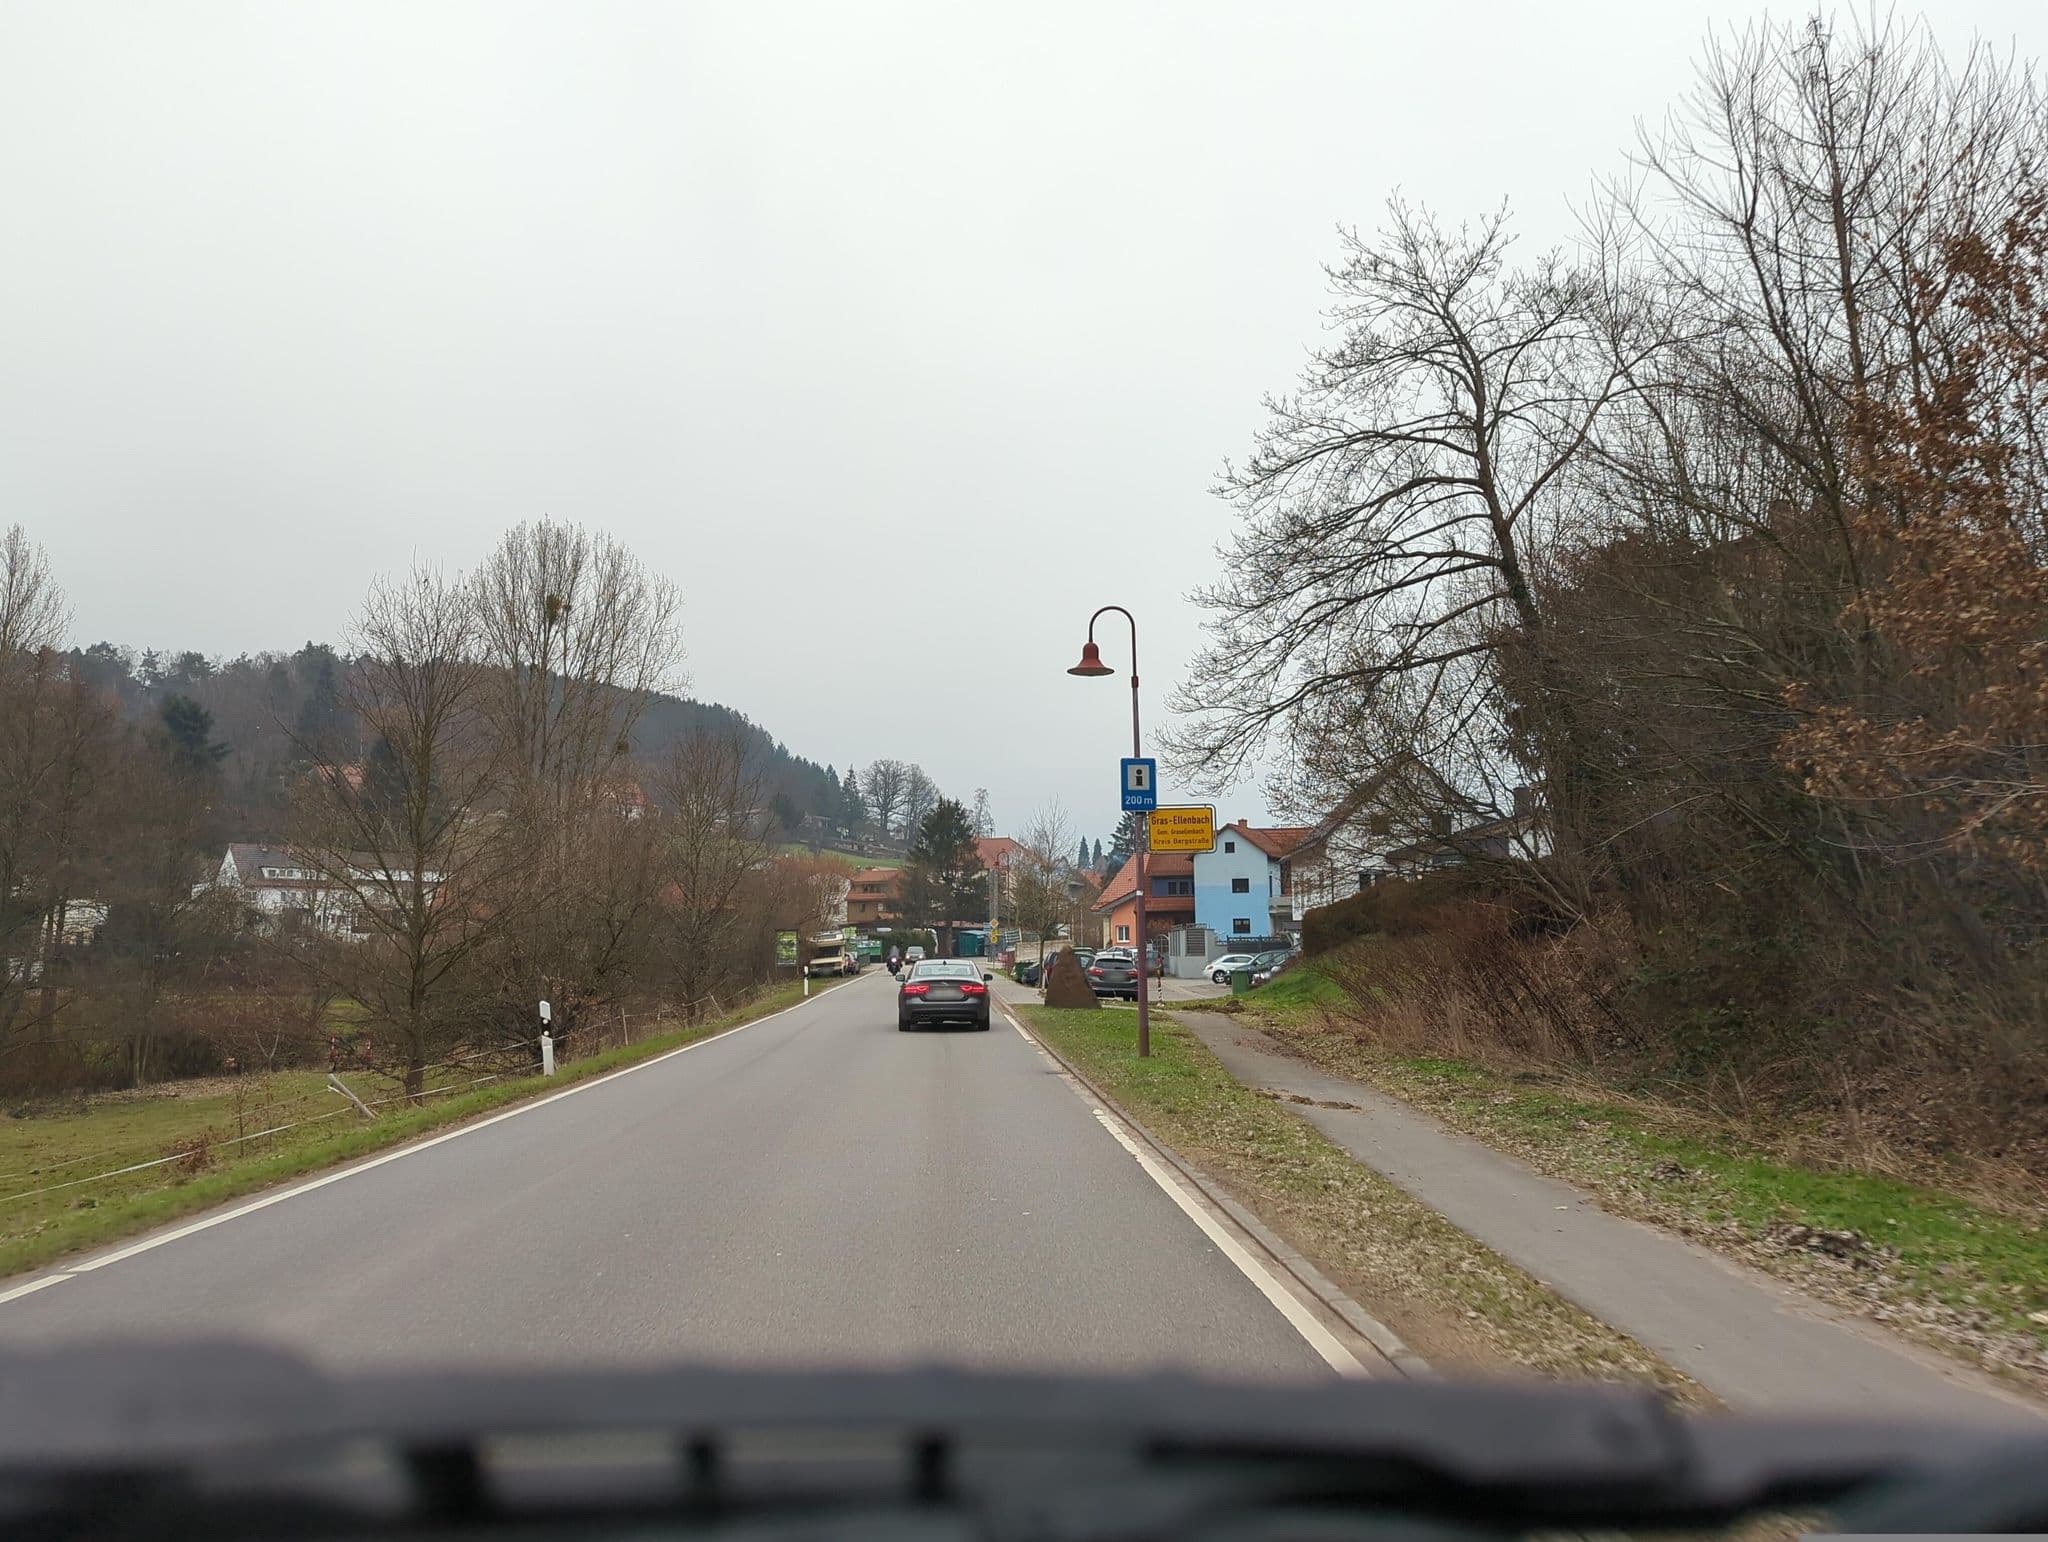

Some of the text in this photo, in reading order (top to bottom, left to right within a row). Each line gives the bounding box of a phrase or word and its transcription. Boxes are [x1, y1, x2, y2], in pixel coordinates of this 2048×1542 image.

[1125, 796, 1153, 805] 200 m
[1151, 815, 1210, 825] Gras-Ellenbach
